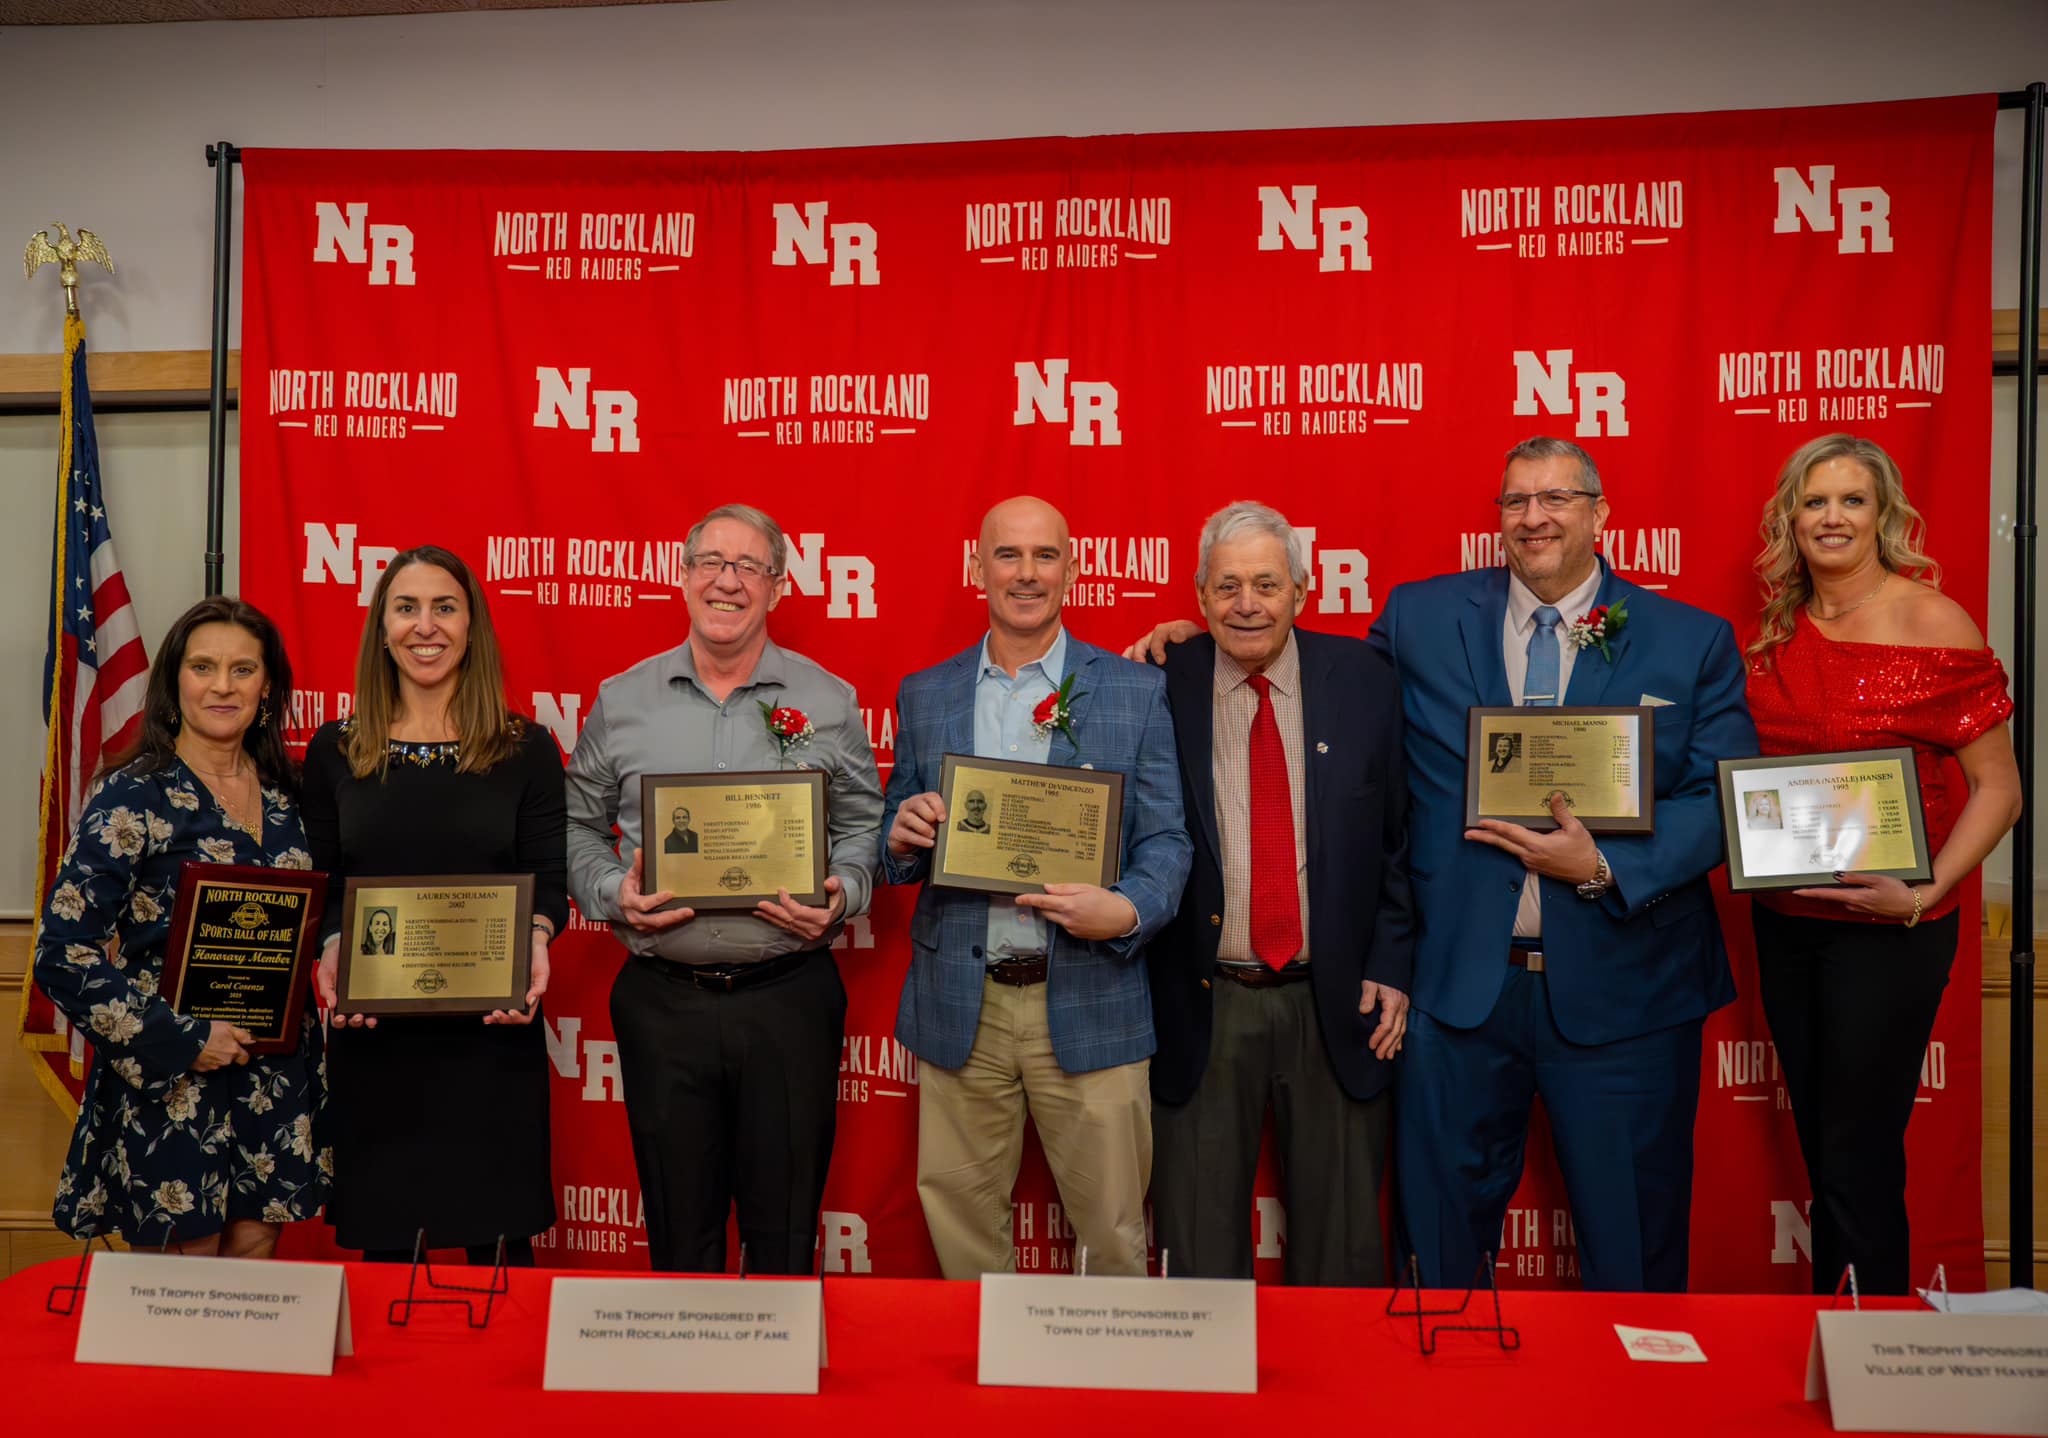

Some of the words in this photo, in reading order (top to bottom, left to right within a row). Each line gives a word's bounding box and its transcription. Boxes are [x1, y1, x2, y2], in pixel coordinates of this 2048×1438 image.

[1461, 187, 1541, 238] NORTH
[1554, 180, 1683, 230] ROCKLAND
[1774, 165, 1894, 254] NR
[494, 211, 567, 257] NORTH
[579, 212, 695, 259] ROCKLAND
[966, 201, 1044, 252] NORTH
[1055, 197, 1171, 246] ROCKLAND
[1257, 184, 1372, 273] NR
[313, 201, 416, 286] NR
[772, 200, 881, 286] NR
[1021, 247, 1048, 271] RED
[1056, 243, 1118, 268] RAIDERS
[1518, 233, 1546, 258] RED
[1557, 230, 1624, 257] RAIDERS
[546, 256, 571, 280] RED
[580, 257, 642, 281] RAIDERS
[1718, 351, 1801, 403] NORTH
[1816, 344, 1945, 395] ROCKLAND
[269, 369, 334, 417] NORTH
[345, 370, 458, 419] ROCKLAND
[723, 376, 798, 424] NORTH
[810, 373, 929, 421] ROCKLAND
[1013, 358, 1122, 446] NR
[1206, 365, 1287, 415] NORTH
[1299, 362, 1423, 412] ROCKLAND
[1513, 348, 1630, 438] NR
[533, 366, 640, 453] NR
[1263, 411, 1291, 436] RED
[1301, 409, 1367, 435] RAIDERS
[1777, 397, 1808, 423] RED
[1819, 394, 1888, 421] RAIDERS
[314, 414, 338, 437] RED
[346, 415, 407, 439] RAIDERS
[776, 420, 802, 445] RED
[812, 419, 874, 444] RAIDERS
[486, 535, 555, 582] NORTH
[566, 537, 684, 588] ROCKLAND
[1461, 532, 1507, 572] NOR
[1602, 527, 1681, 577] KLAND
[537, 581, 559, 605] RED
[567, 583, 632, 608] RAIDERS
[1062, 583, 1116, 607] AIDERS
[1010, 777, 1047, 789] MATTHEW
[1787, 778, 1821, 788] ANDREA
[1821, 775, 1859, 786] (NATALE)
[1859, 773, 1894, 783] HANSEN
[724, 793, 743, 802] BILL
[205, 888, 243, 904] NORTH
[244, 891, 299, 909] ROCKLAND
[416, 892, 451, 901] LAUREN
[451, 891, 499, 900] SCHULMAN
[199, 922, 233, 940] SPORTS
[234, 927, 256, 941] HALL
[257, 929, 269, 941] OF
[269, 927, 293, 942] FAME
[192, 948, 247, 965] Honorary
[248, 951, 291, 965] Member
[563, 1184, 646, 1230] ROCKLA
[567, 1227, 627, 1253] RAIDERS
[1517, 1254, 1545, 1277] RED
